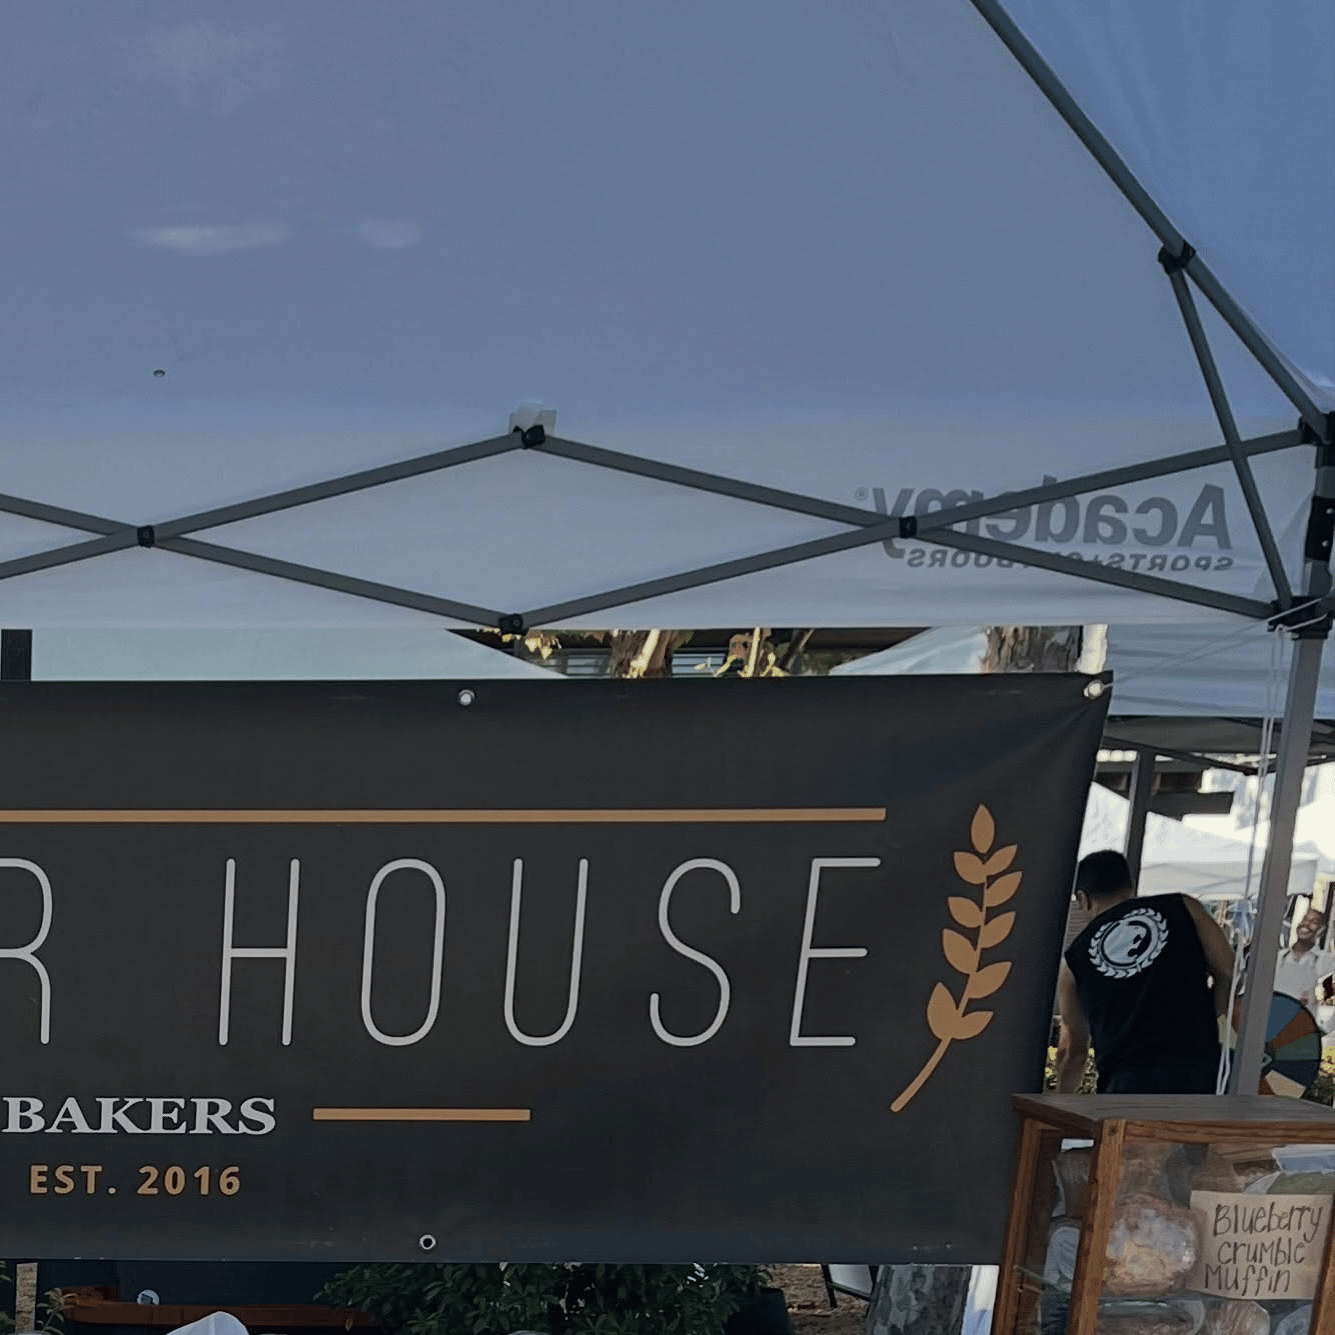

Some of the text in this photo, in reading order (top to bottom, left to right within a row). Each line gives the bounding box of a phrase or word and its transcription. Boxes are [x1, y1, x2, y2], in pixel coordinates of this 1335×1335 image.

[218, 857, 882, 1048] HOUSE
[0, 1096, 276, 1135] BAKERS
[29, 1164, 241, 1196] EST. 2016
[1213, 1201, 1324, 1244] Blueberry
[1204, 1263, 1291, 1297] Muffin
